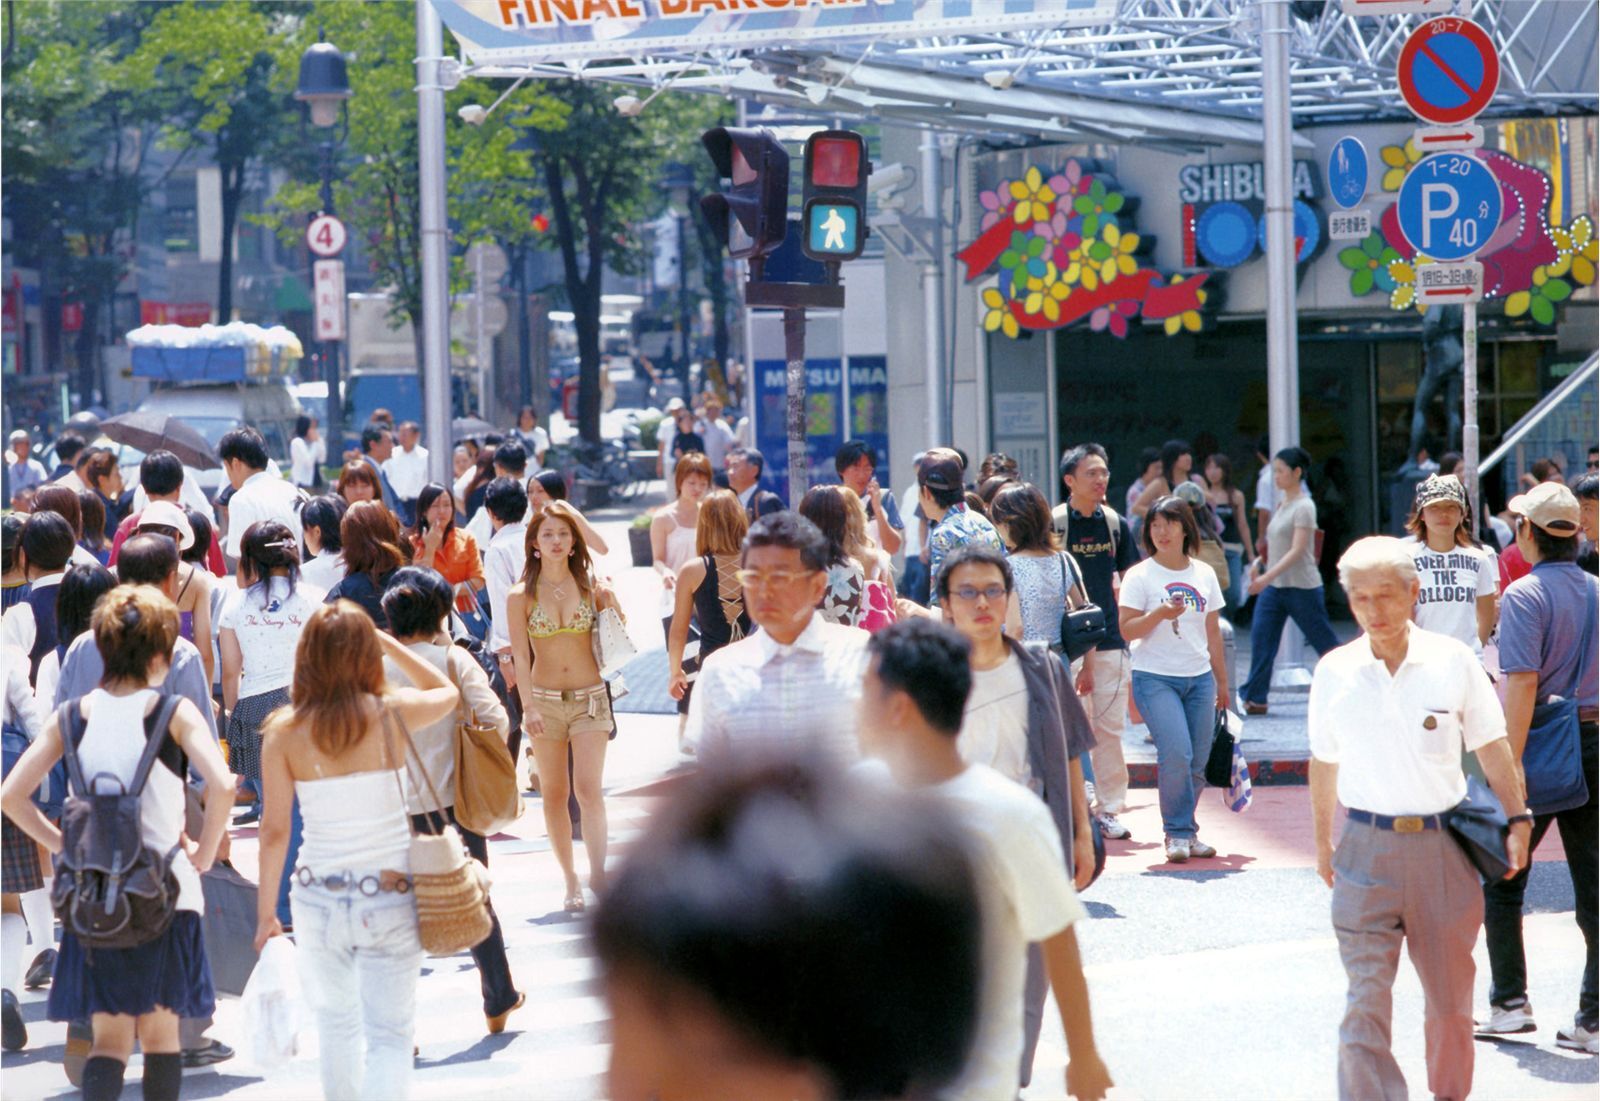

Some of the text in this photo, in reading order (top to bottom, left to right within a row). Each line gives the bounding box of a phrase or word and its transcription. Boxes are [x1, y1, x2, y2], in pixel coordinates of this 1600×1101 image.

[1430, 20, 1463, 34] 20-7
[1180, 162, 1315, 202] SHIBUA
[1421, 183, 1460, 249] P
[316, 223, 333, 248] 4
[1449, 218, 1478, 248] 40
[764, 368, 841, 388] MSU
[1414, 554, 1446, 573] EVER
[1432, 570, 1458, 586] THE
[1418, 586, 1477, 605] OLLOCK
